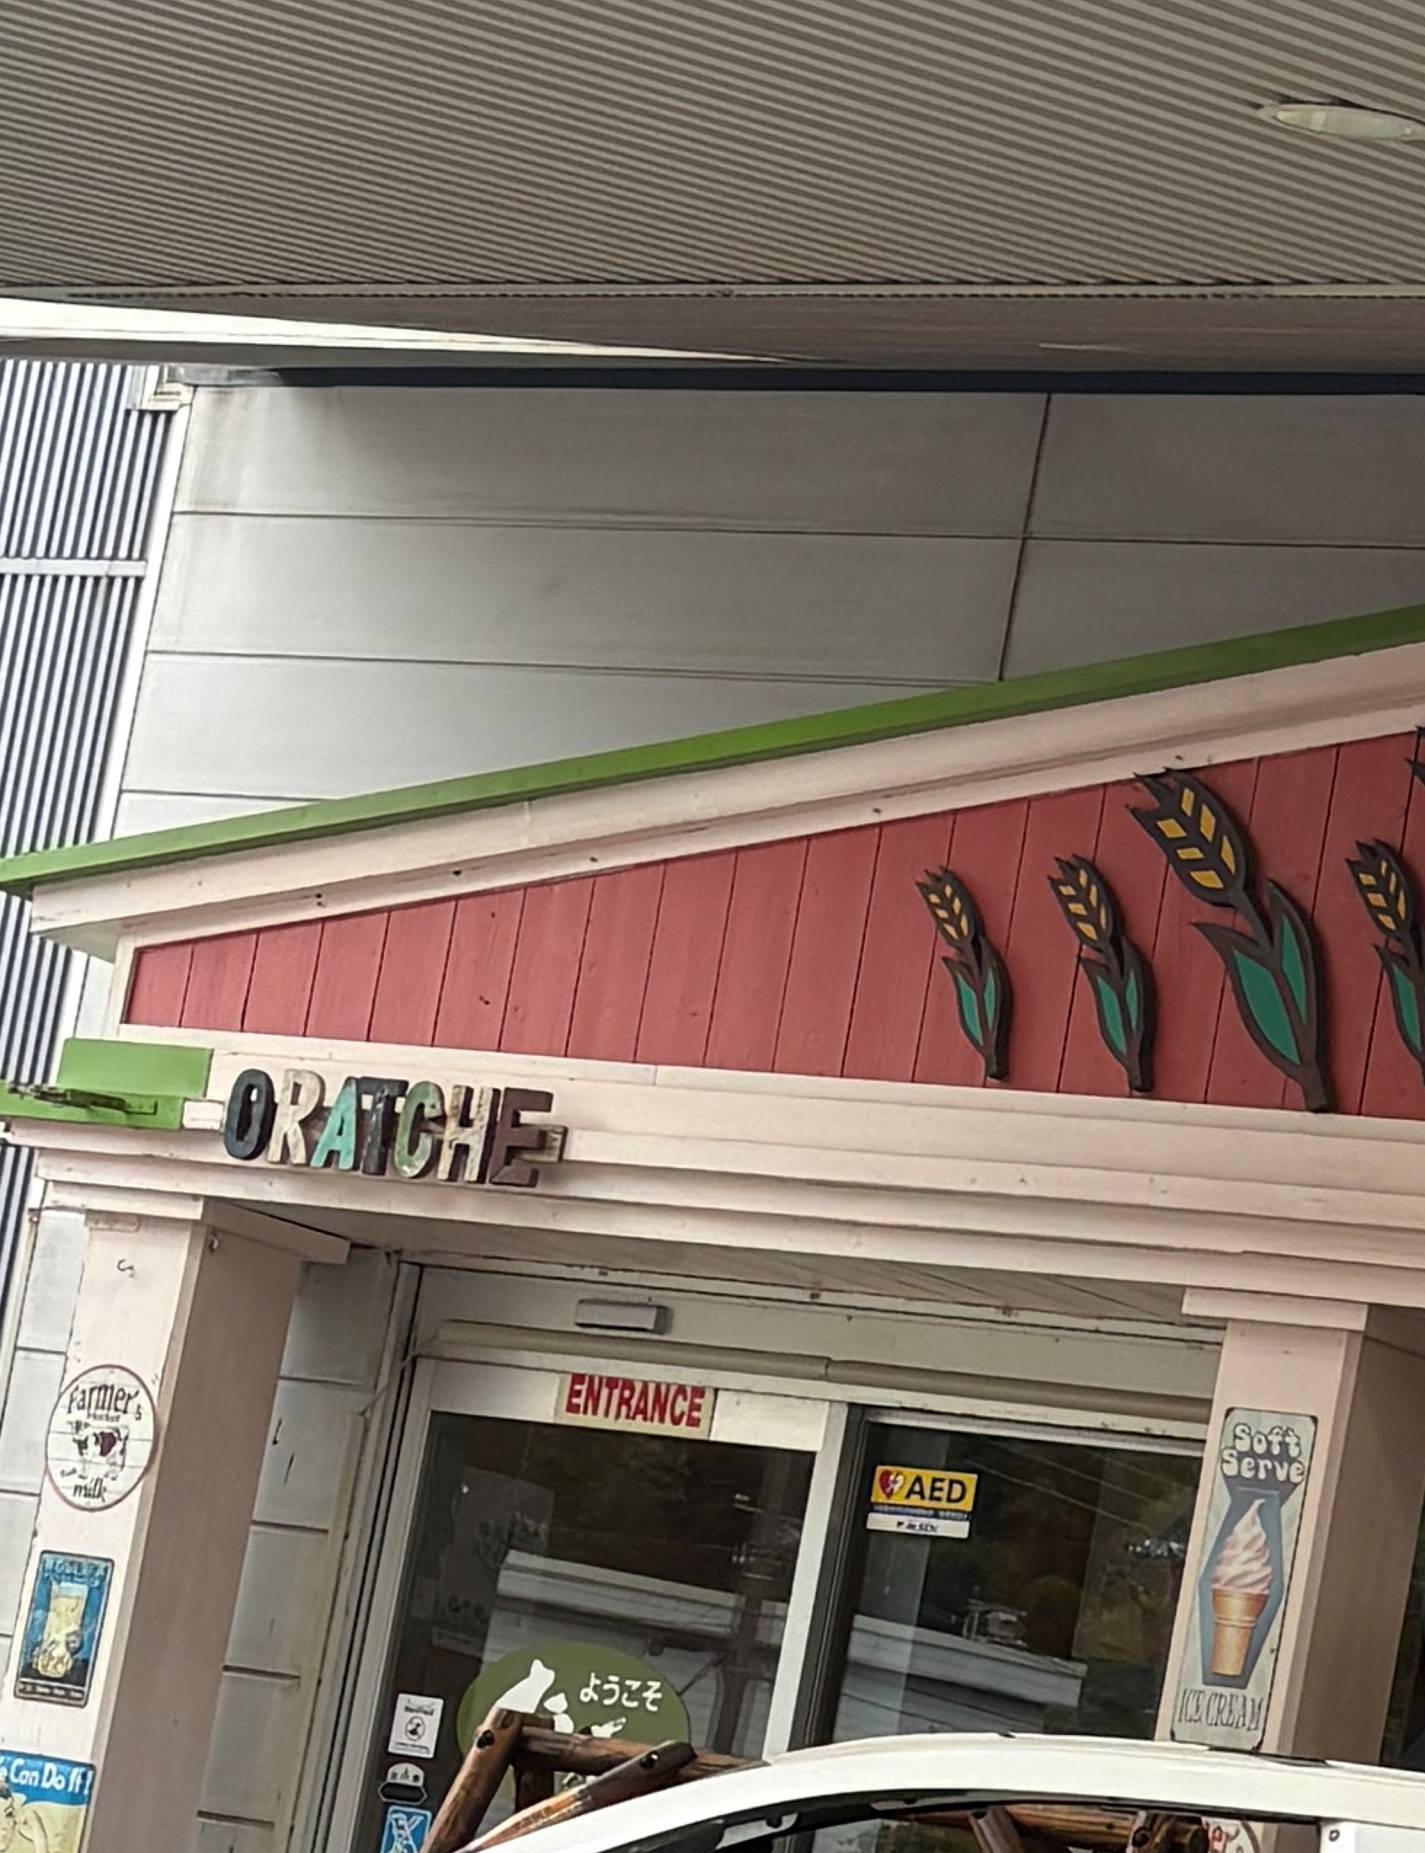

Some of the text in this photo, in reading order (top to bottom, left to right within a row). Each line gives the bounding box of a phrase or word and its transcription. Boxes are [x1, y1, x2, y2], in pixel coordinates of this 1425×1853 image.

[223, 1068, 556, 1188] ORATCHE
[564, 1373, 704, 1428] ENTRANCE
[1232, 1422, 1302, 1459] Soft
[1221, 1448, 1305, 1485] Serve
[904, 1474, 967, 1504] AED
[579, 1672, 663, 1713] ようこそ
[1177, 1688, 1264, 1731] ICE CREAM
[10, 1758, 39, 1787] Can
[41, 1762, 66, 1790] Do
